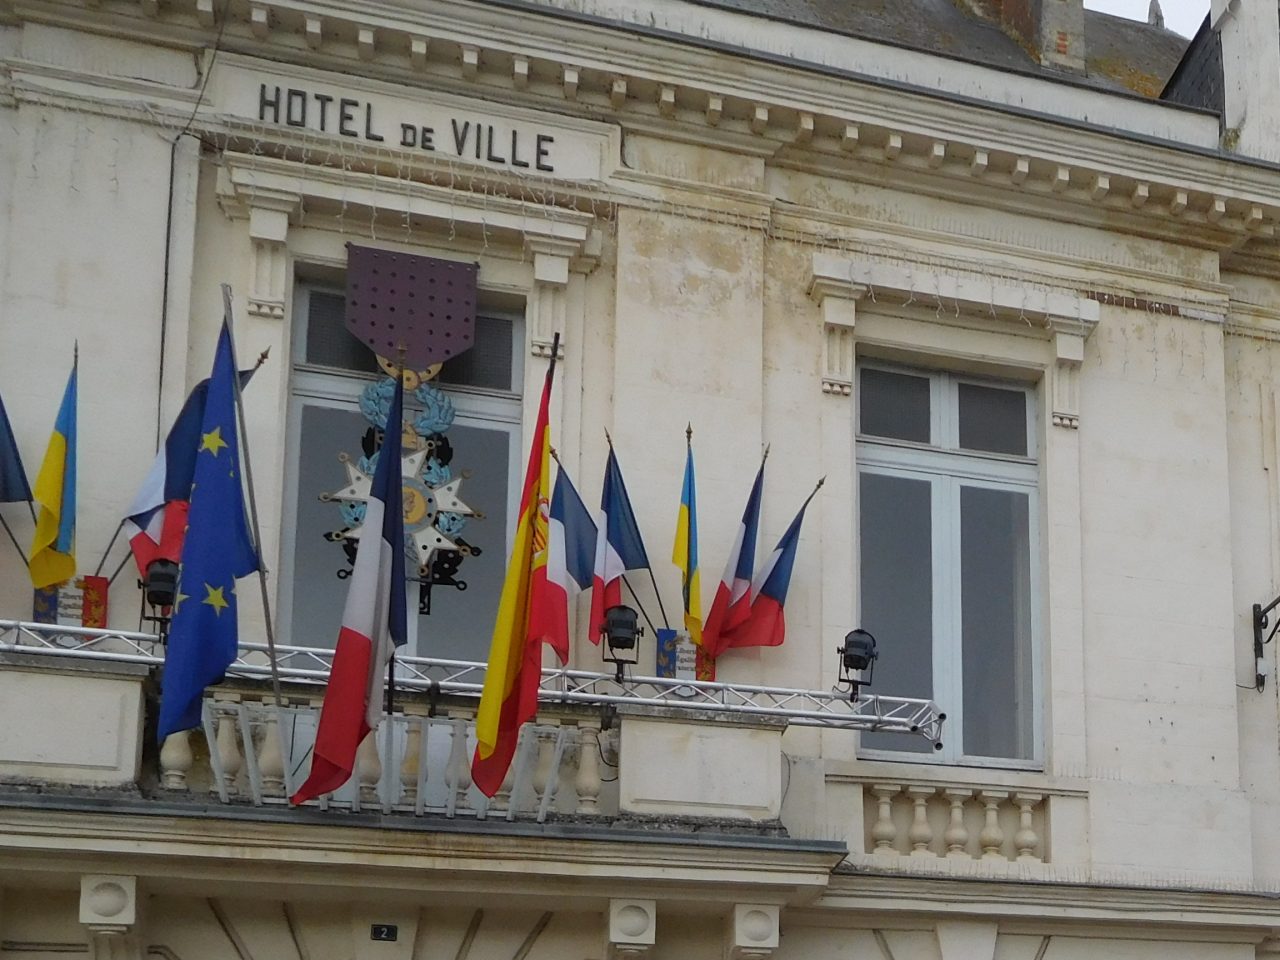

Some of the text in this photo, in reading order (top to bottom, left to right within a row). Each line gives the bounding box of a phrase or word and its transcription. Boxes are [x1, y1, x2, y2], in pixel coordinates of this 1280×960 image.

[258, 83, 555, 173] HOTEL DE VILLE
[380, 927, 388, 938] 2
